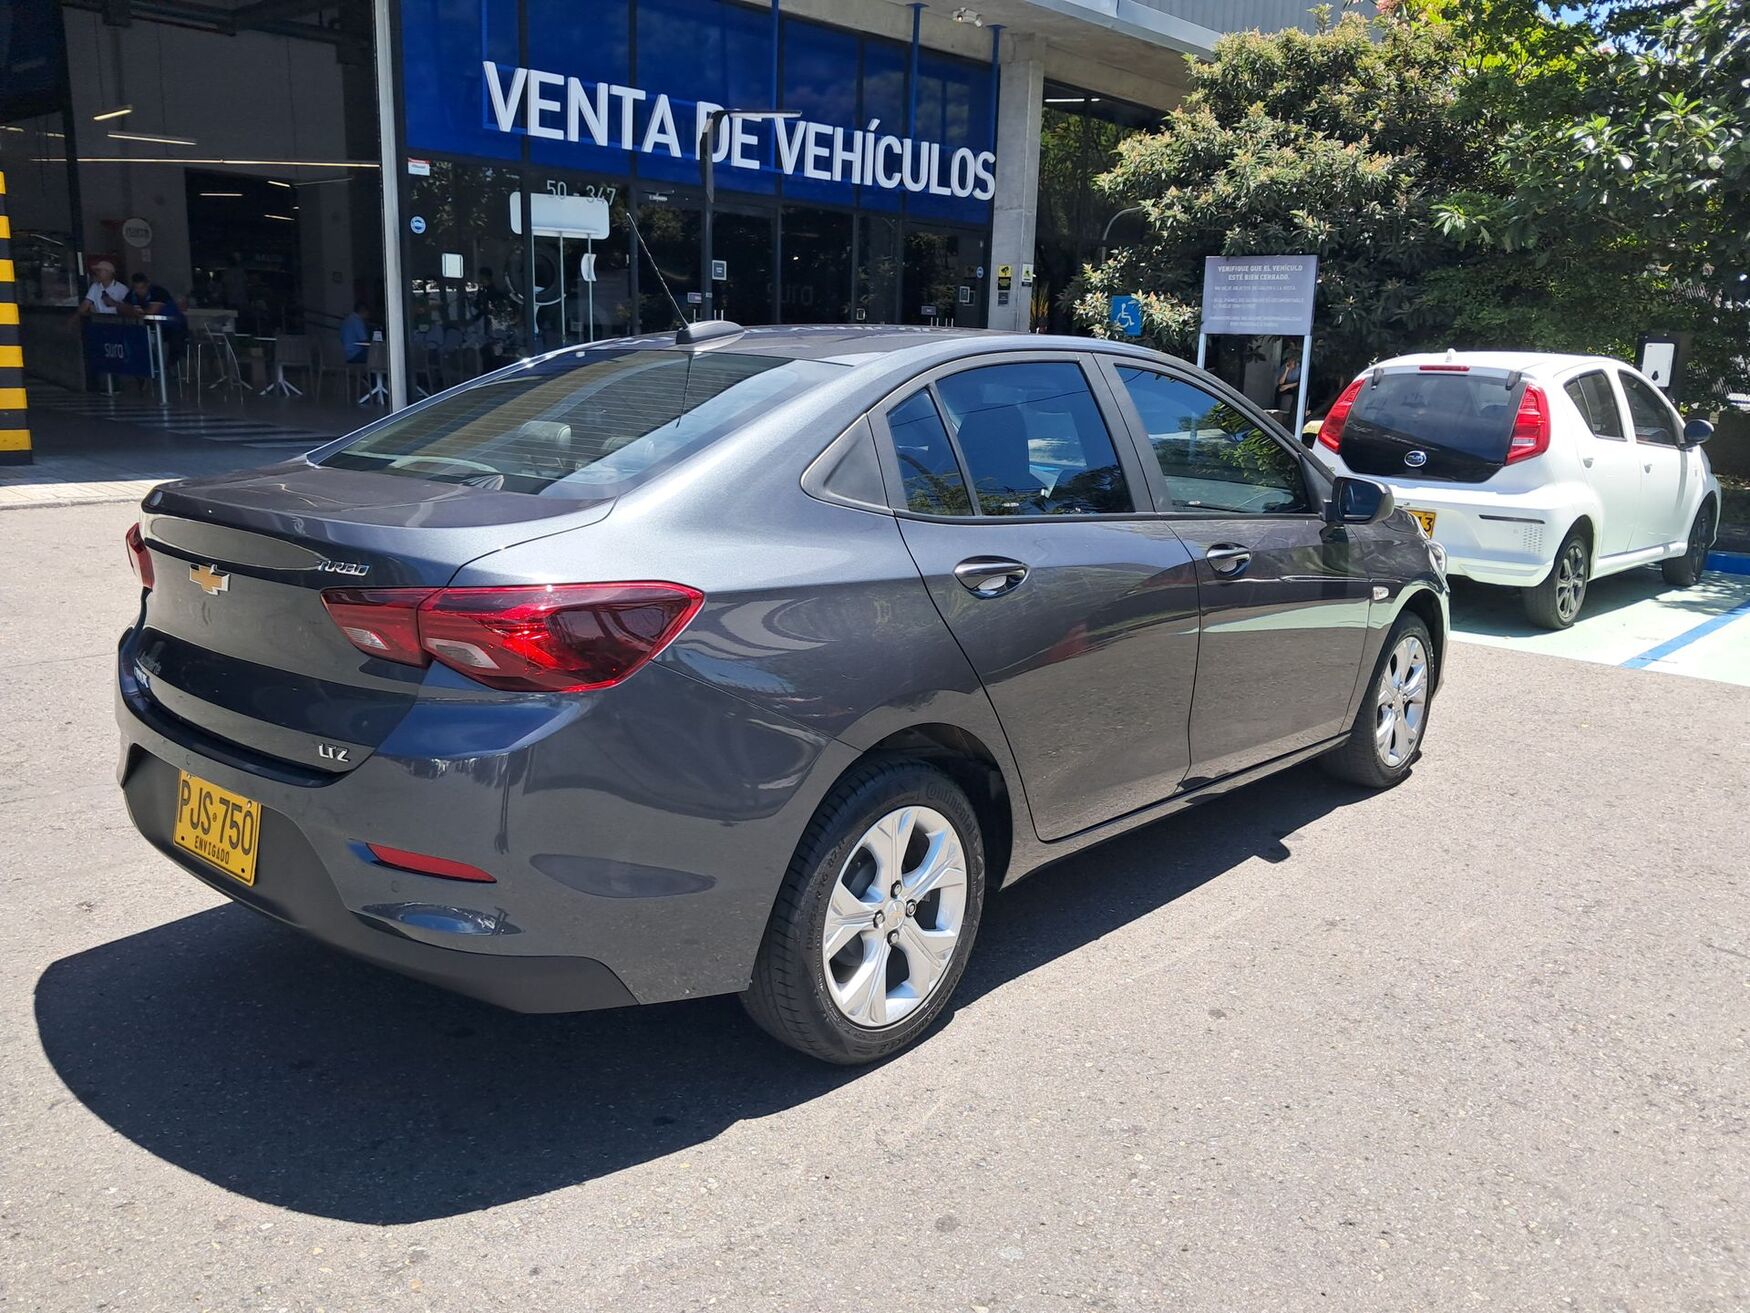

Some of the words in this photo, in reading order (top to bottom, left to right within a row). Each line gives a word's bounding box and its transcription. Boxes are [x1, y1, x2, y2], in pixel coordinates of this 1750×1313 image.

[482, 60, 682, 158] VENTA
[696, 101, 762, 170] DE
[774, 116, 996, 201] VEHÍCULOS
[546, 180, 567, 200] 50
[586, 185, 616, 206] 347
[317, 560, 369, 576] TURBO
[319, 744, 349, 762] LTZ
[178, 779, 213, 836] PJS
[219, 797, 254, 856] 750
[194, 835, 230, 865] ENVIGADO
